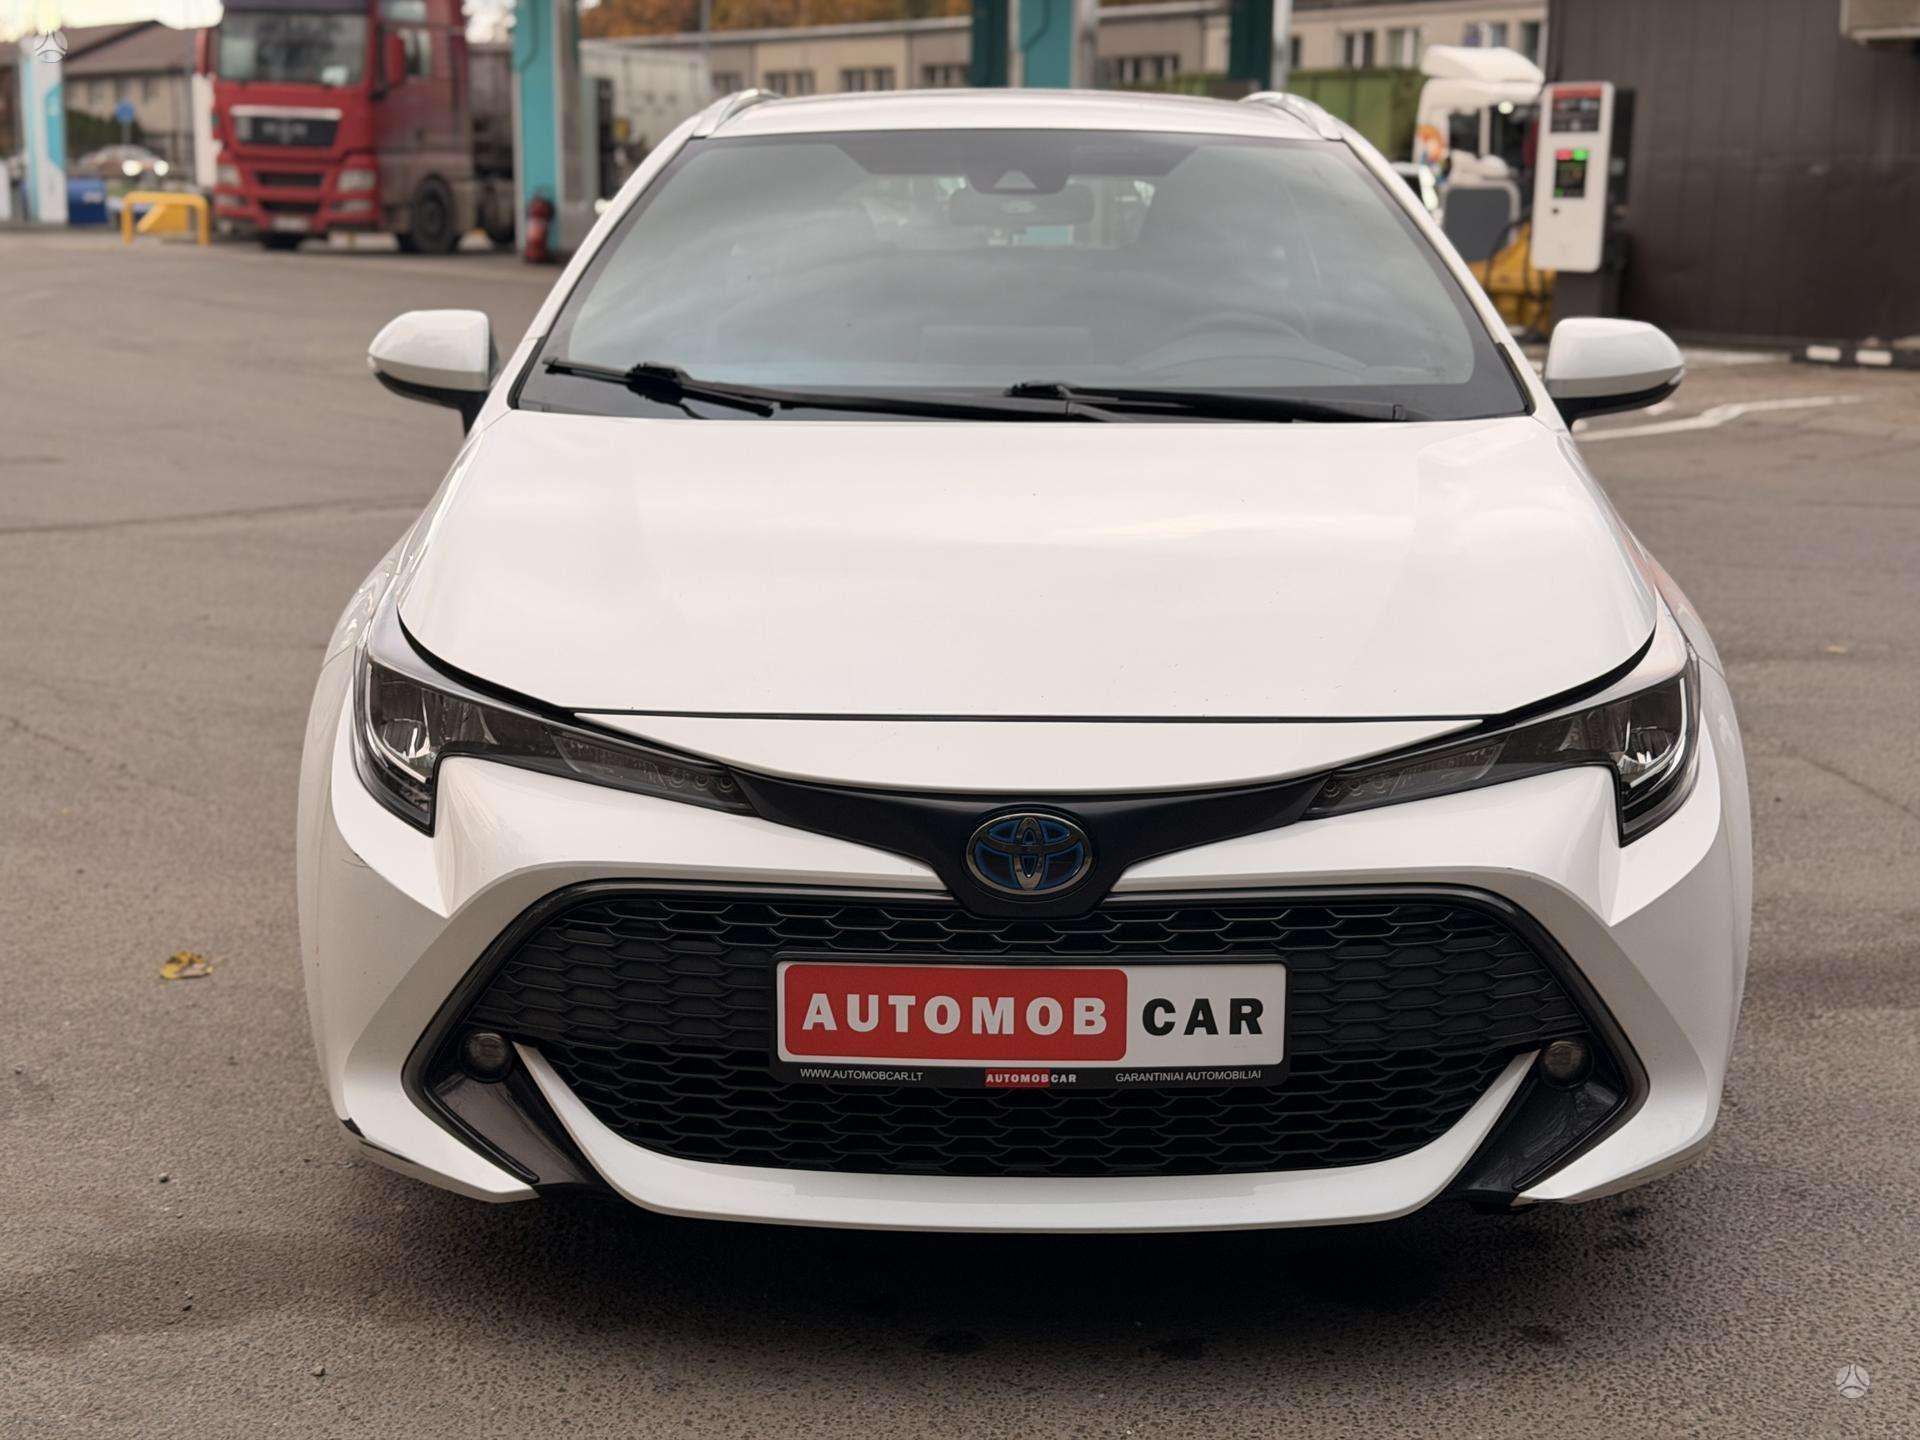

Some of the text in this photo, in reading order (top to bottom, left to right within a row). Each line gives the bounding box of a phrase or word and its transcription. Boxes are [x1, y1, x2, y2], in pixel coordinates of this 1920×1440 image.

[802, 993, 1264, 1037] AUTOMOB CAR
[800, 1068, 924, 1082] WWW.AUTOMOBCAR.LT
[1115, 1069, 1262, 1083] GARANTINIAI AUTOMOBILIAI
